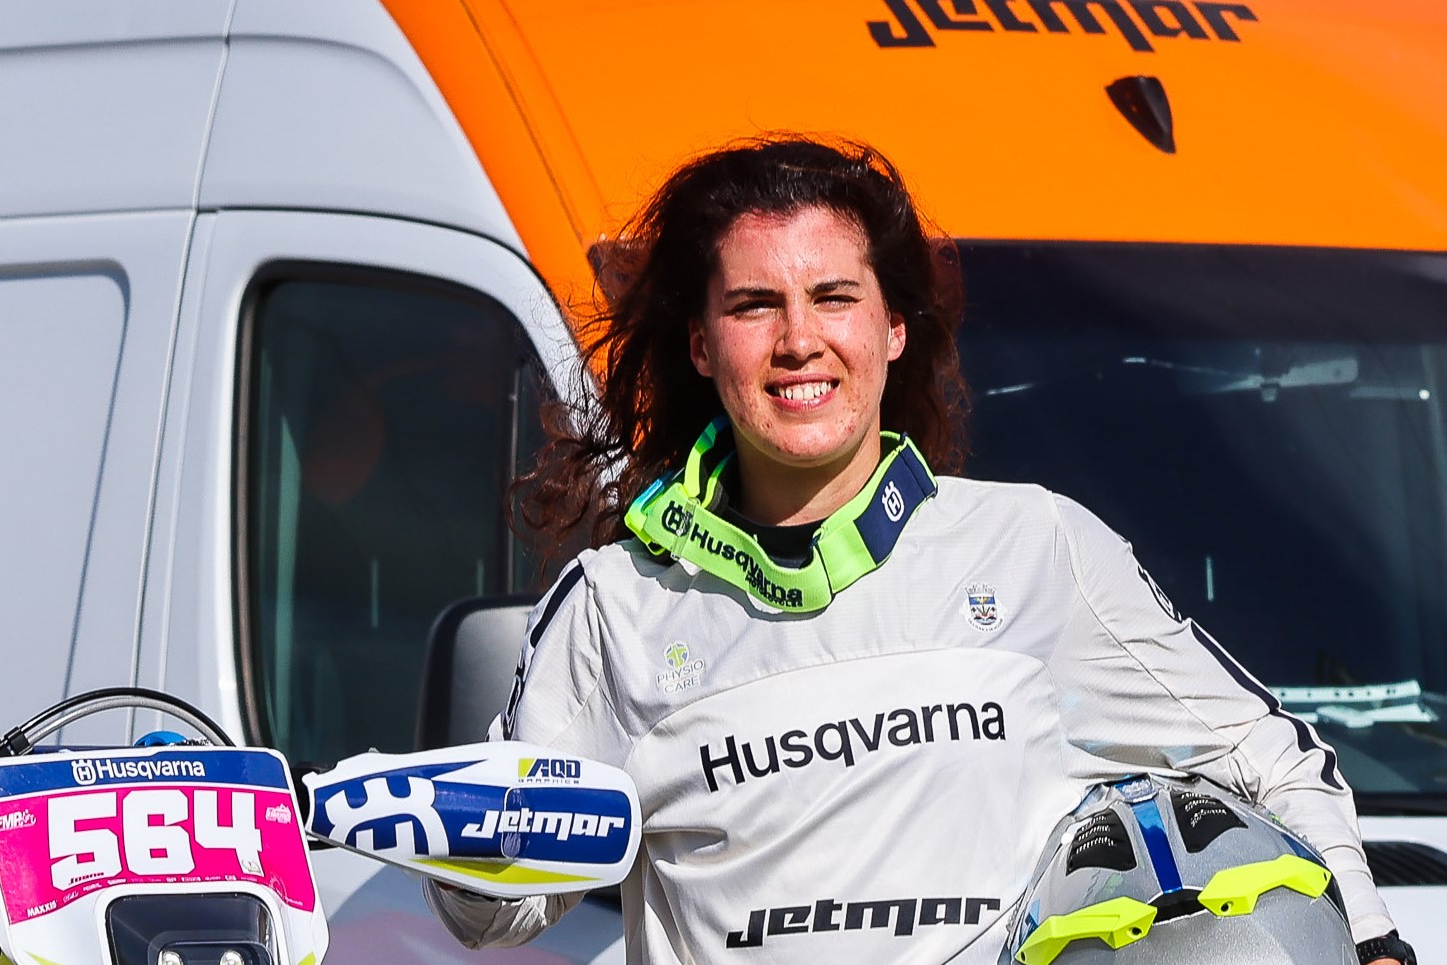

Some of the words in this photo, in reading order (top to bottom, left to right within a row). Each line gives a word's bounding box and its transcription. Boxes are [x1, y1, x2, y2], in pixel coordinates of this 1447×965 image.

[690, 522, 803, 601] Husqvarna
[657, 660, 704, 684] PHYSIO
[664, 676, 698, 693] CARE
[699, 701, 1007, 793] Husqvarna
[95, 759, 206, 780] Husqvarna
[47, 789, 264, 892] 564
[27, 899, 58, 918] MAXXIS
